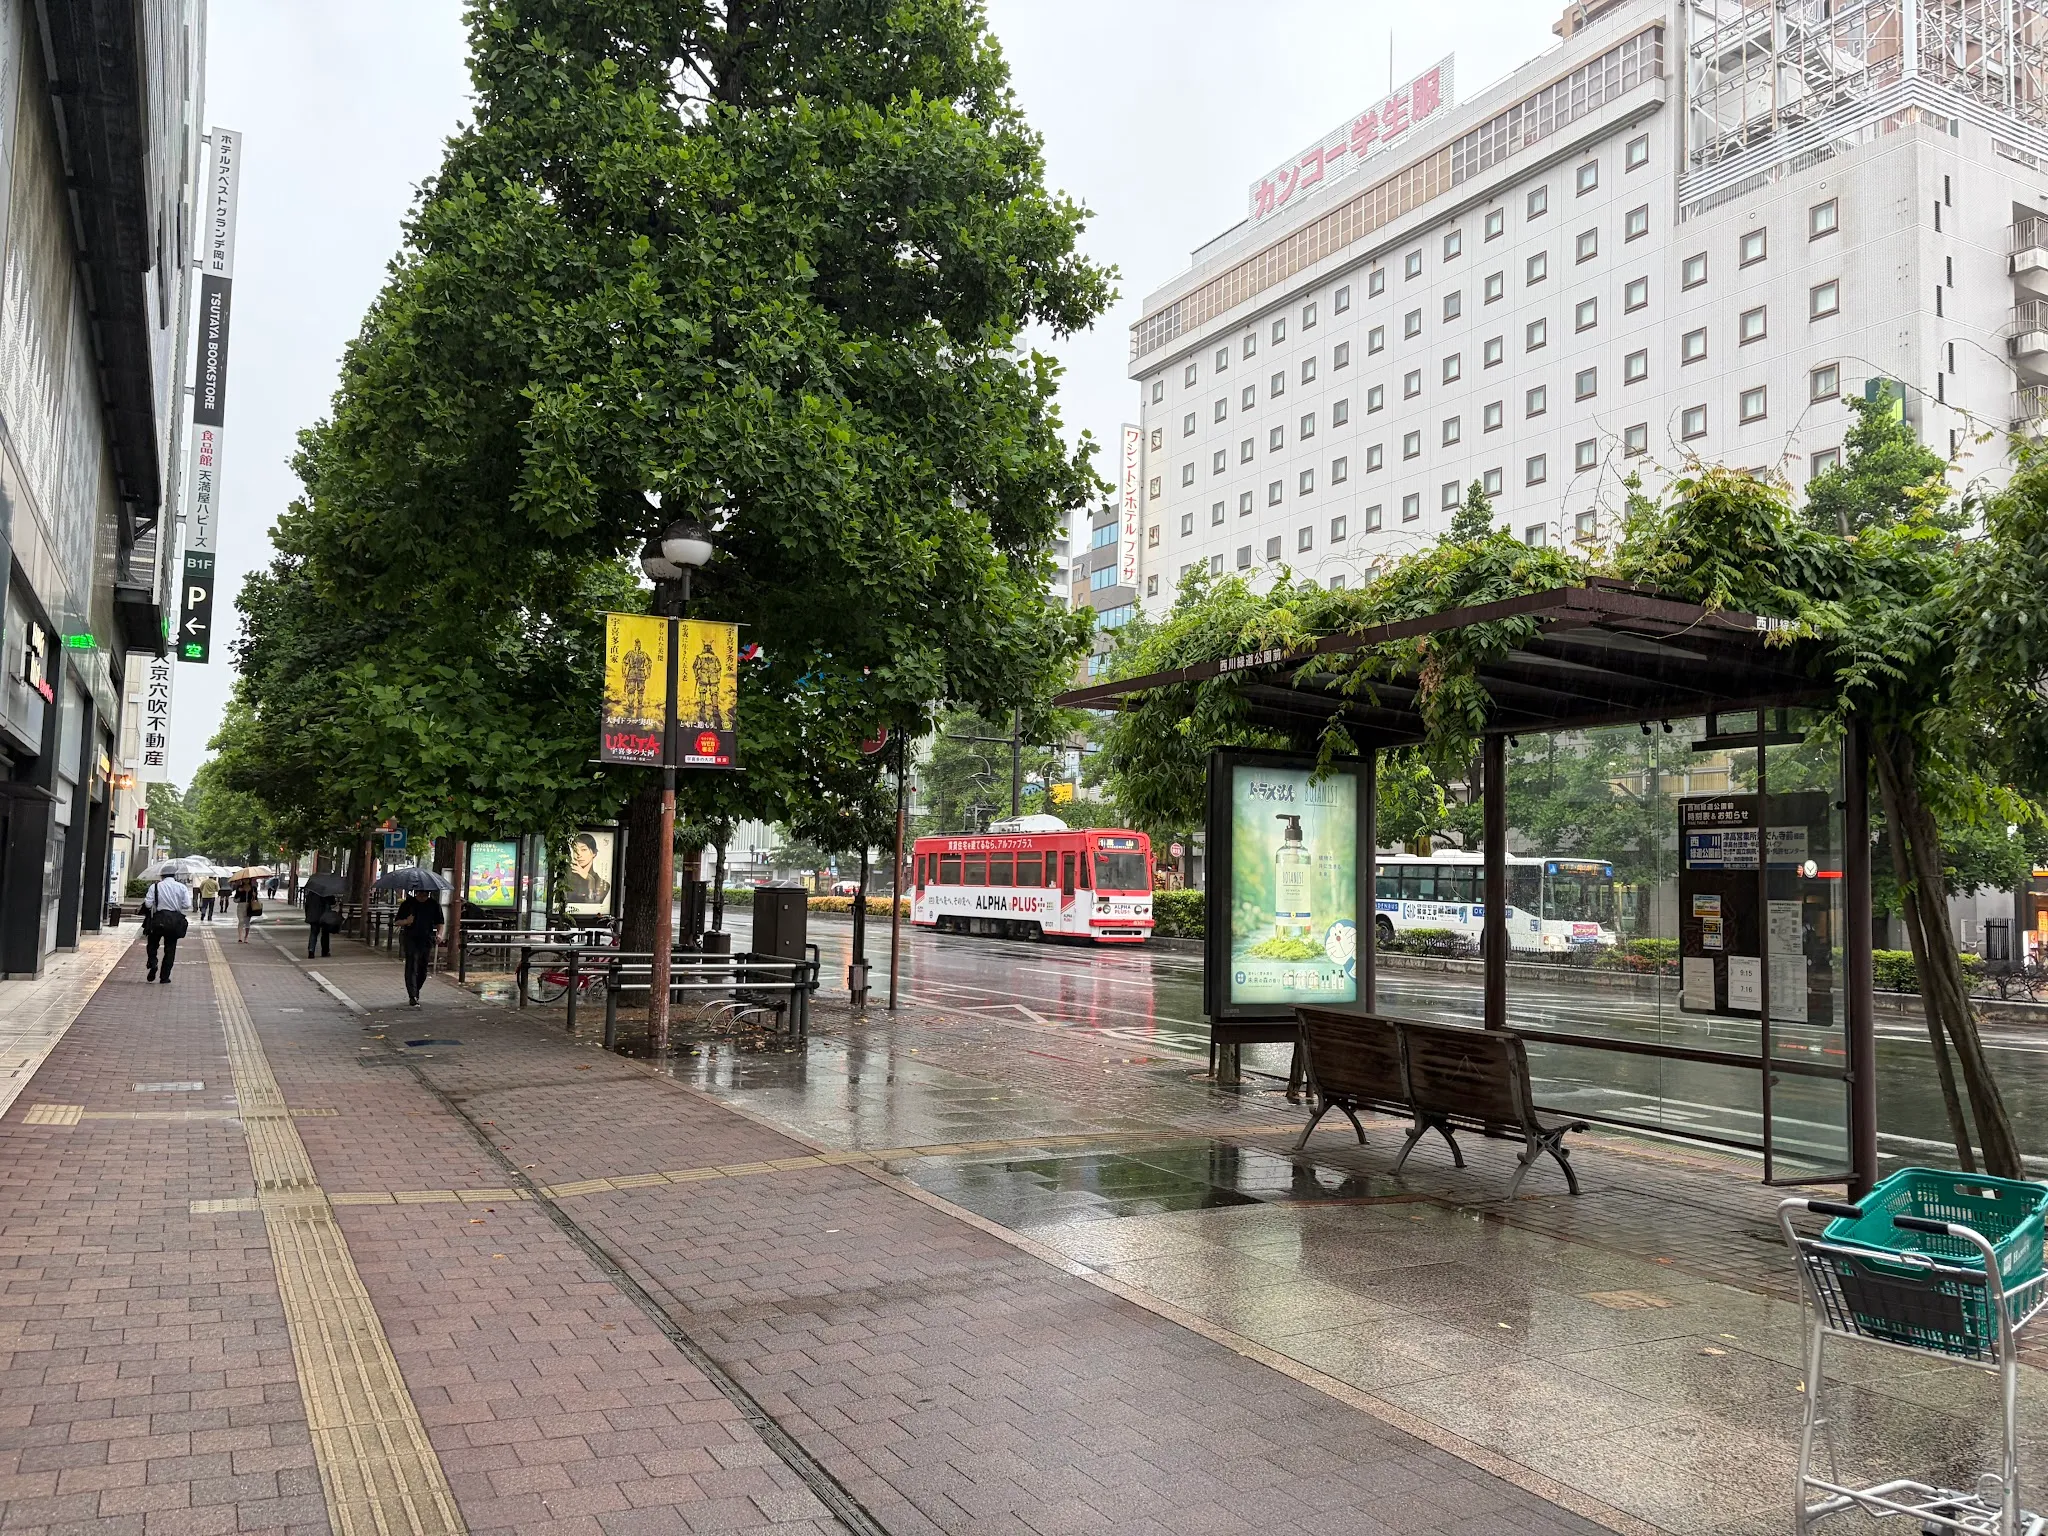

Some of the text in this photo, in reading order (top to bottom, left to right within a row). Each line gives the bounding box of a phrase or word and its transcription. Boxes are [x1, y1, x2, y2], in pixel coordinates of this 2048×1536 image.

[1255, 66, 1441, 220] カンコー学生服
[213, 134, 232, 271] ホテルアベストグランデ岡山
[204, 292, 222, 410] TSUTAYA BOOKSTORE
[194, 431, 214, 548] 食品館 天満屋ハピーズ
[1122, 430, 1139, 580] ワシントンホテル プラザ
[187, 557, 213, 570] B1F
[188, 587, 207, 610] P
[185, 643, 202, 657] 空
[1219, 648, 1282, 672] 西川緑道公園前
[605, 732, 661, 754] UKITA
[610, 747, 655, 757] 宇喜多の大河
[1249, 781, 1338, 804] ドラえもん BOTANIST
[390, 829, 403, 847] P
[976, 896, 1008, 911] ALPHA
[1012, 896, 1037, 912] PLUS
